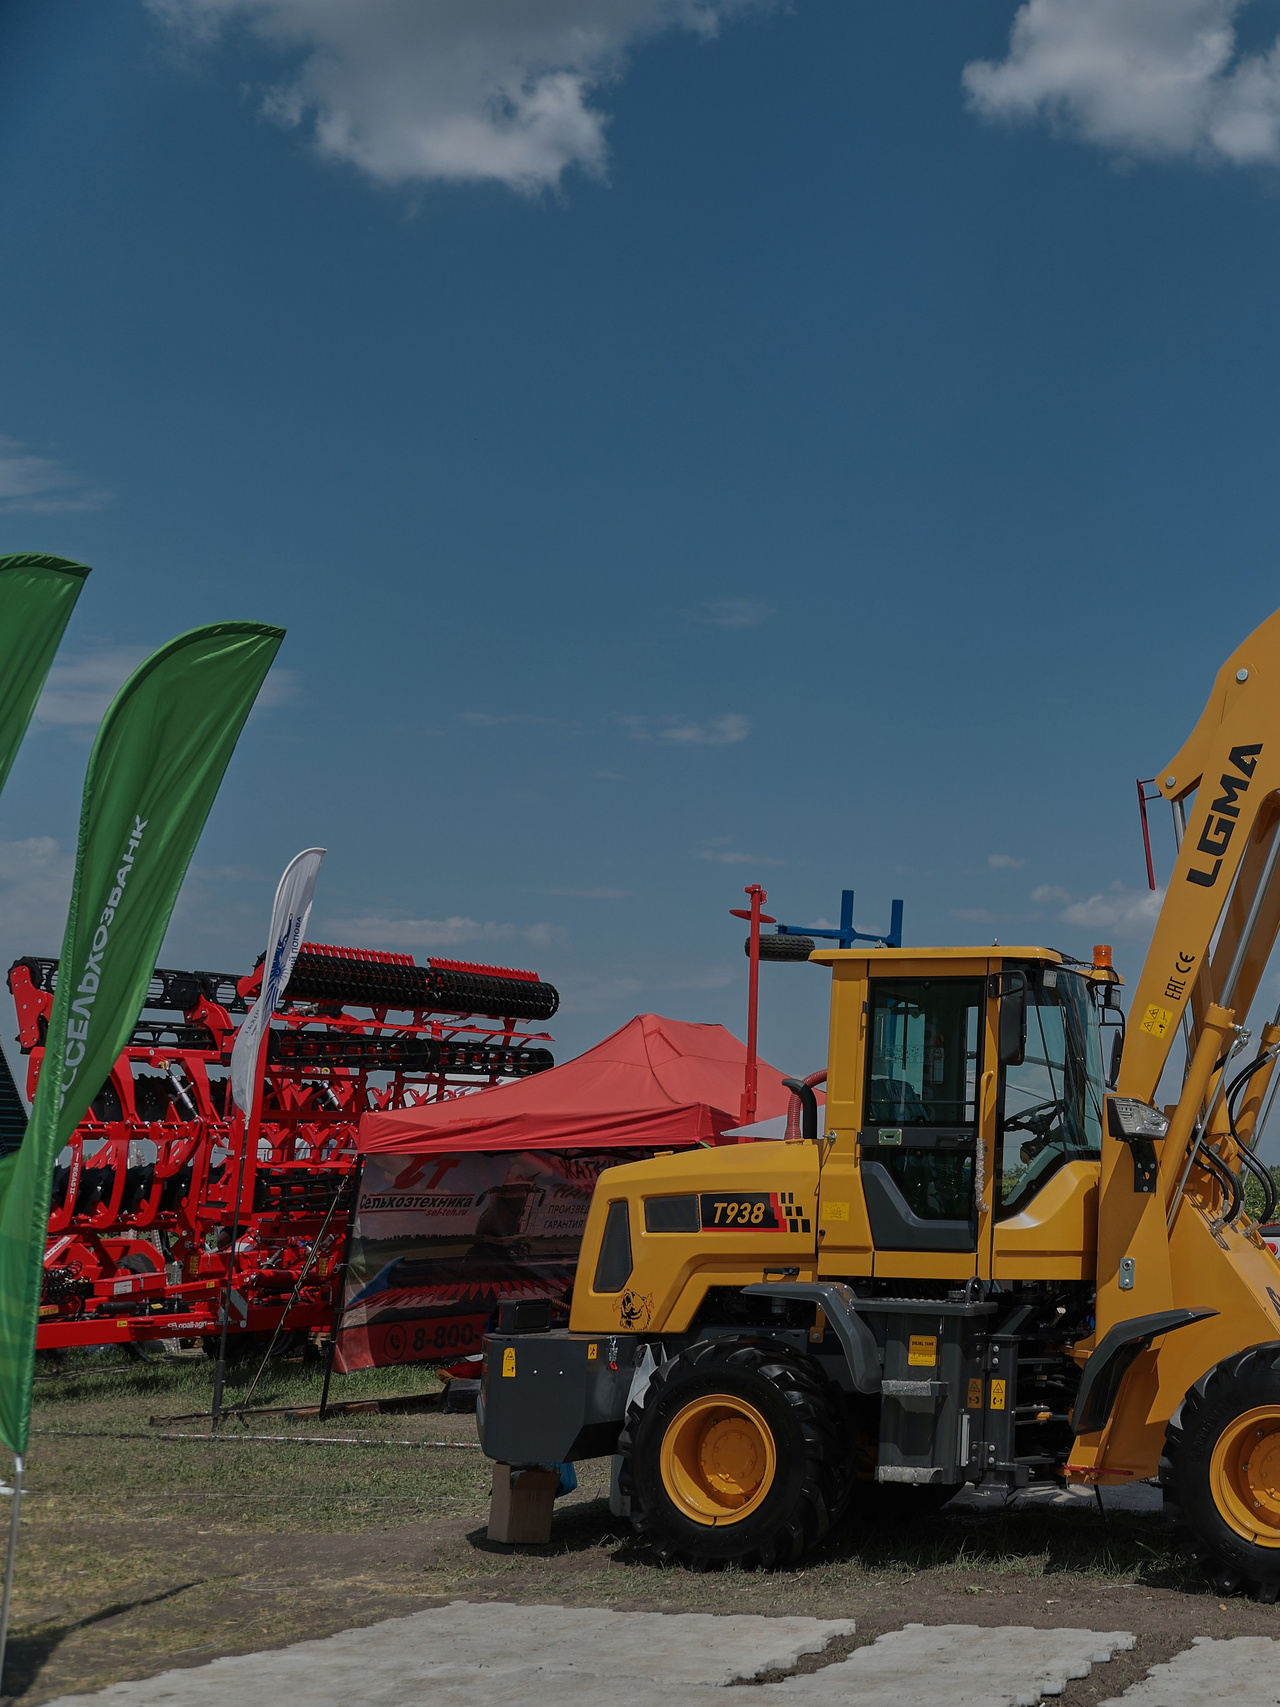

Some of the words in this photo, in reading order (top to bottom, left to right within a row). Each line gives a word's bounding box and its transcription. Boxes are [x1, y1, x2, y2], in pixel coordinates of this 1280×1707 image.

[1186, 743, 1264, 888] LGMA
[291, 916, 302, 954] ПОПОВА
[58, 814, 149, 1112] ССЕЛЬХОЗБАНК
[1175, 951, 1196, 974] CE
[1163, 976, 1187, 1001] EAC
[360, 1194, 473, 1210] Сельхозтехника
[425, 1207, 468, 1217] sel-teh.ru
[548, 1204, 590, 1215] ПРОИЗВЕД
[713, 1202, 766, 1224] T938
[543, 1219, 583, 1229] ГАРАНТИЯ
[412, 1323, 489, 1352] 8-800-
